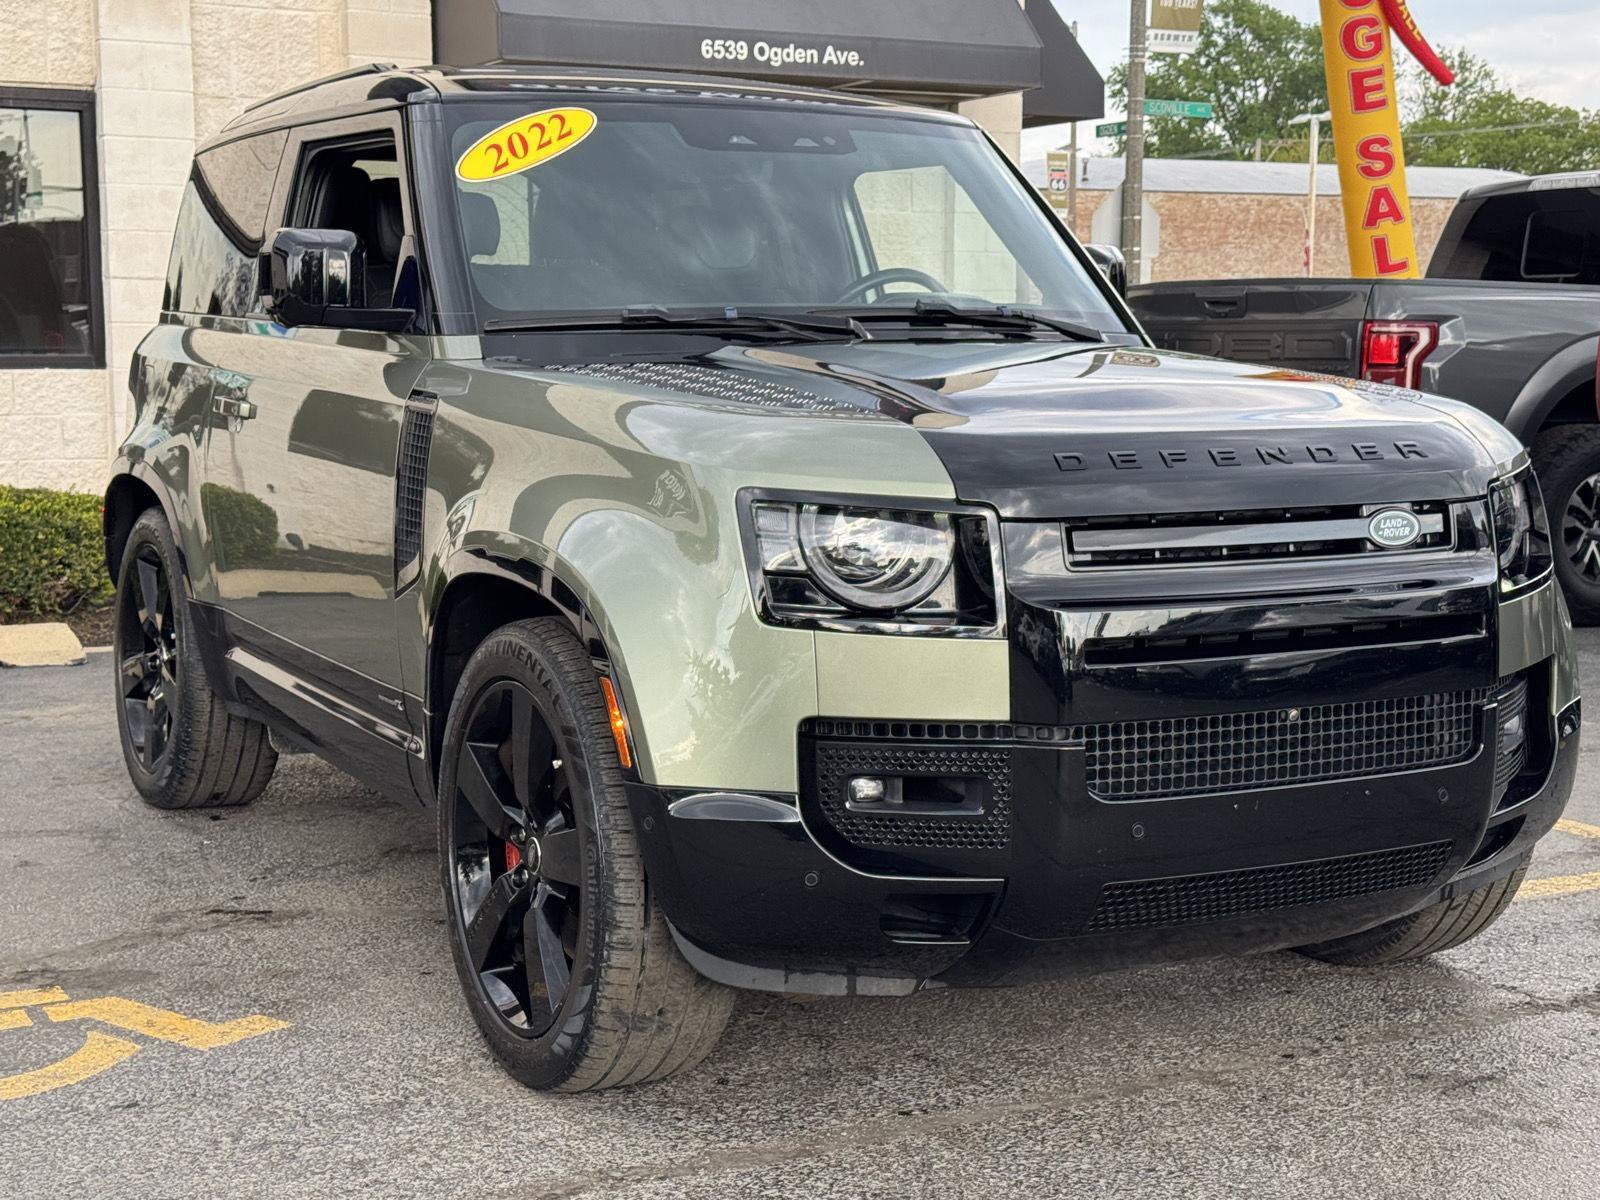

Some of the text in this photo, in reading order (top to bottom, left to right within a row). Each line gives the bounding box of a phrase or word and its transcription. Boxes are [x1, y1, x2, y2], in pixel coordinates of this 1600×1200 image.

[1395, 0, 1421, 42] ALE
[701, 39, 865, 67] 6539 Ogden Ave.
[1339, 0, 1388, 114] GE
[1149, 102, 1191, 115] SCOVILLE
[484, 114, 573, 173] 2022
[1051, 179, 1066, 190] 66
[1053, 441, 1429, 472] DEFENDER
[1381, 519, 1402, 528] LAND
[1384, 527, 1411, 538] ROVER
